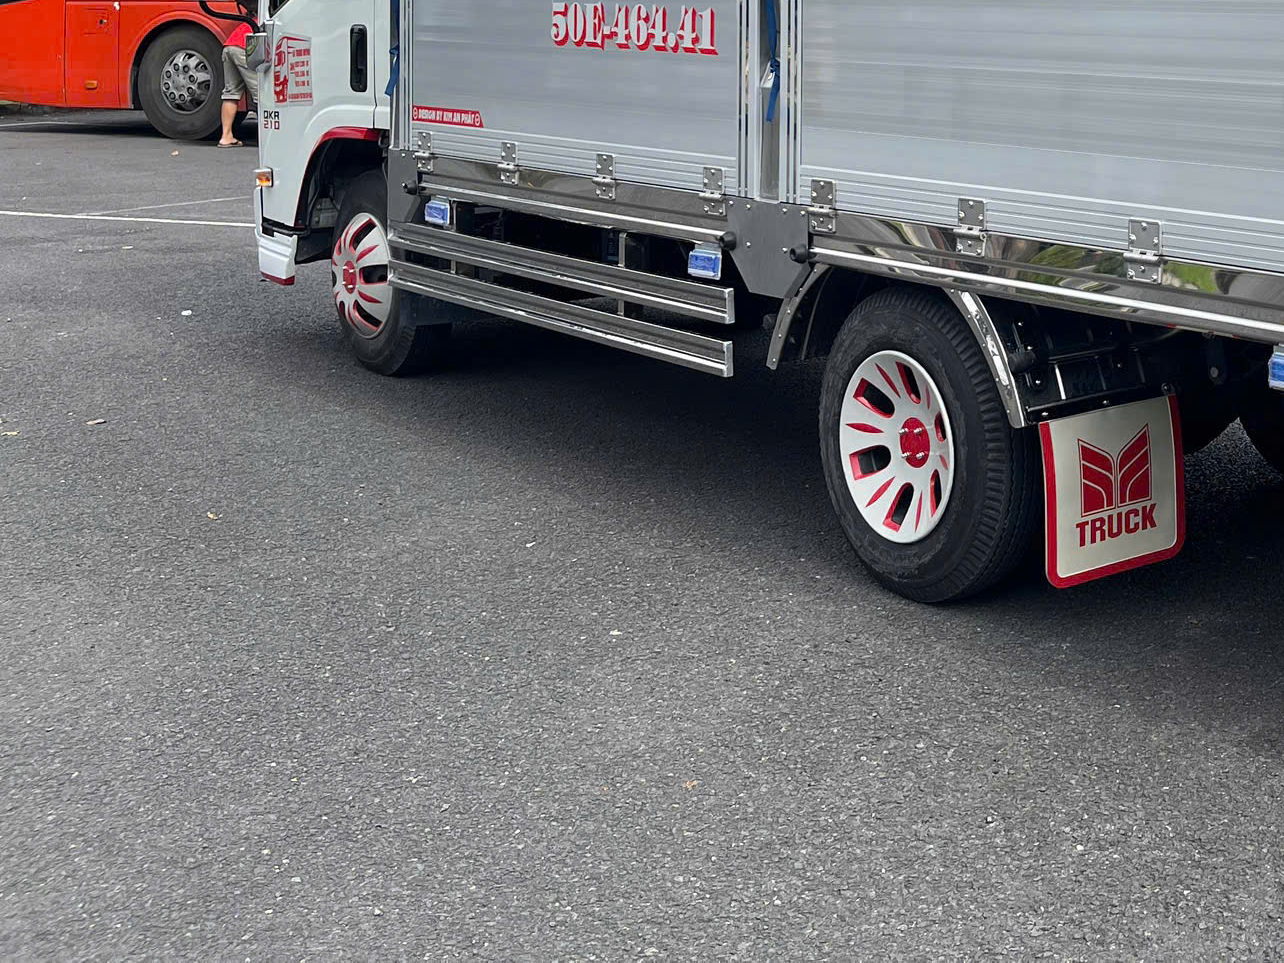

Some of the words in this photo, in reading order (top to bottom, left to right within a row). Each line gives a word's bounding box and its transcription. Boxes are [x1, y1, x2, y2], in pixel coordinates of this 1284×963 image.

[550, 1, 719, 56] 50E-464.41
[263, 120, 280, 130] 210
[1075, 503, 1157, 548] TRUCK
